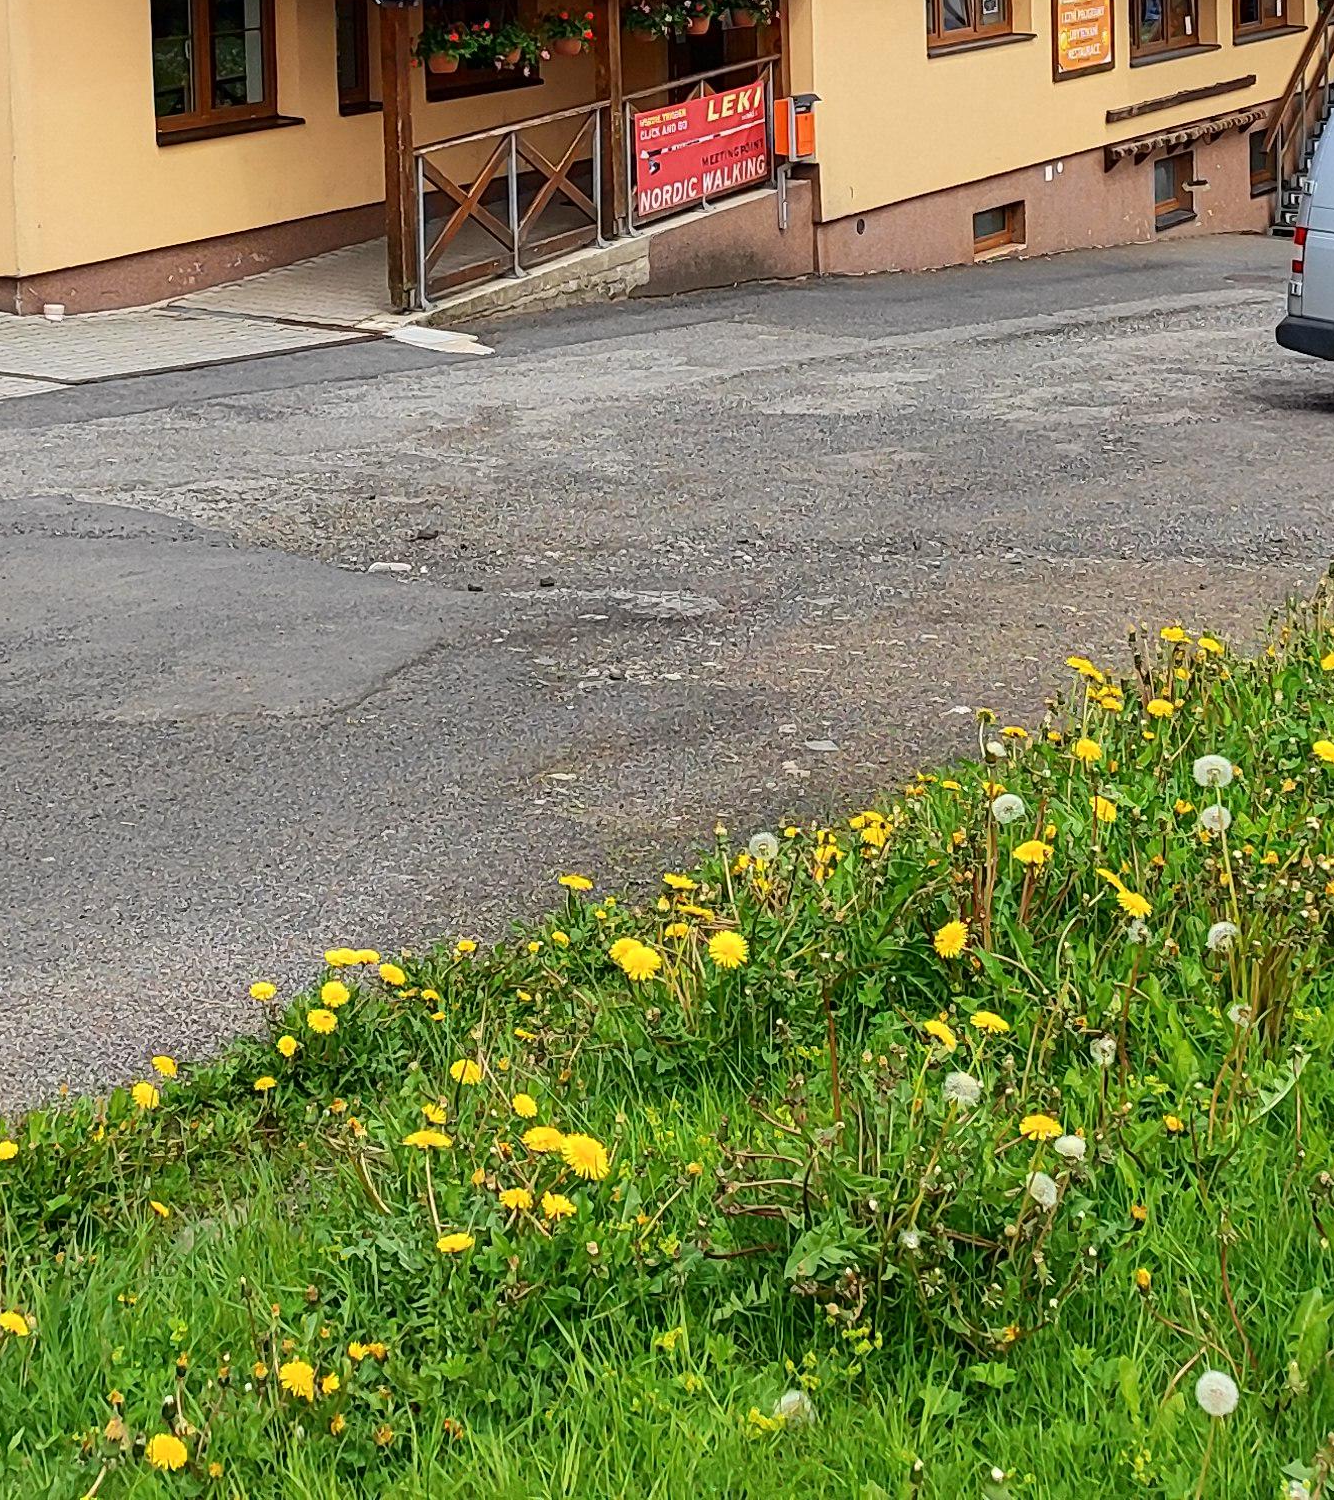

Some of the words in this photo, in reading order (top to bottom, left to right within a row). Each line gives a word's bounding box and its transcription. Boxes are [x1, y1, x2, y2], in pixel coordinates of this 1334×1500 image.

[707, 86, 762, 122] LEKI
[639, 177, 697, 213] NORDIC
[703, 155, 766, 195] WALKING
